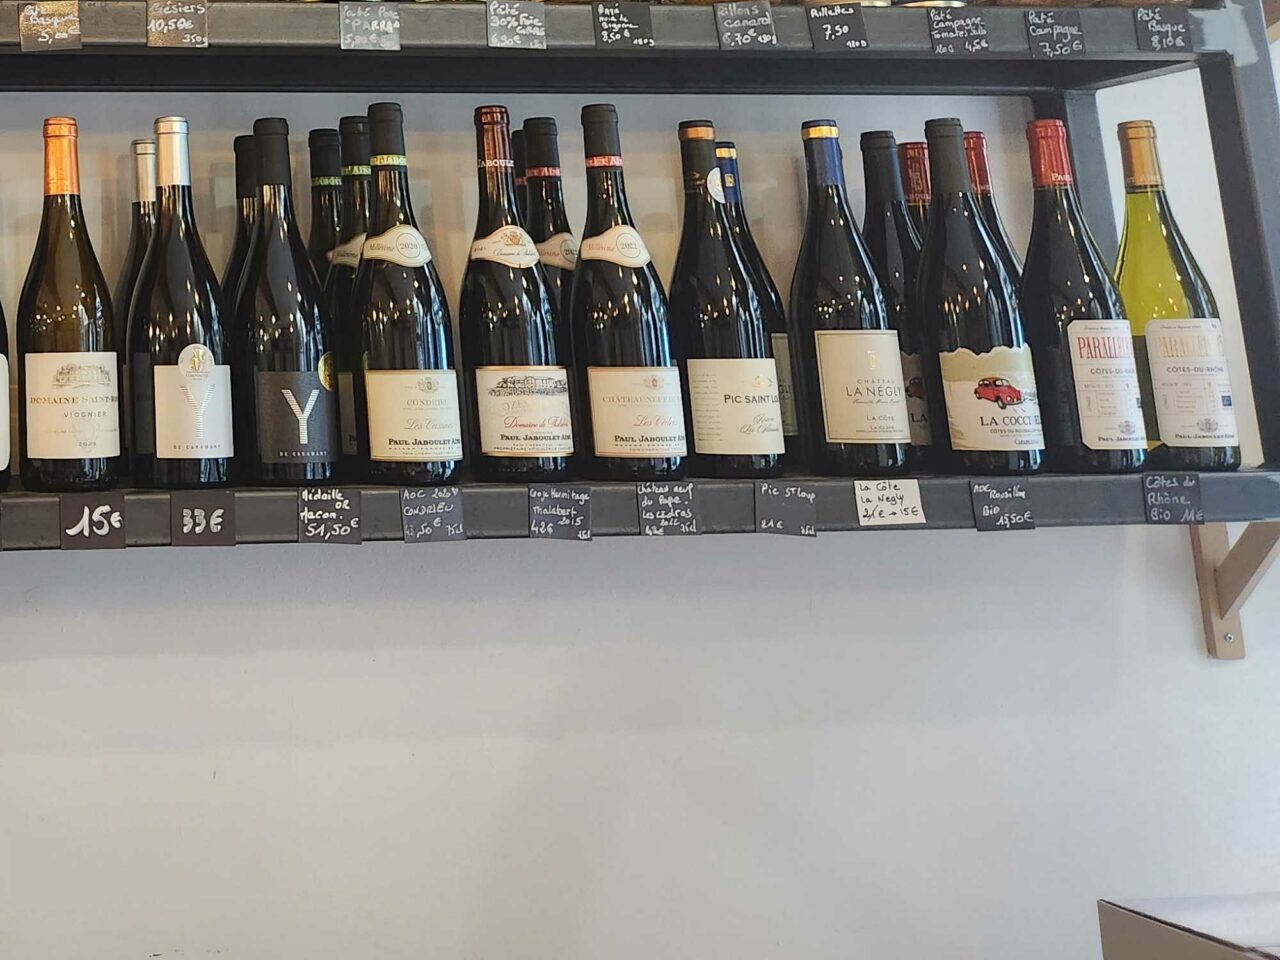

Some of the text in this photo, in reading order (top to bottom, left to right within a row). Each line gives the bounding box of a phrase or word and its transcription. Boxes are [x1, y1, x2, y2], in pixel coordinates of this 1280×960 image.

[490, 14, 543, 28] 30% Foie
[724, 11, 771, 28] canard
[822, 24, 849, 40] 7,50
[1030, 25, 1082, 42] Campagne
[1148, 22, 1185, 38] Basque
[846, 386, 863, 397] LA
[31, 396, 78, 404] DOMAINE
[724, 394, 770, 404] PIC SAINT
[179, 384, 216, 439] Y
[281, 389, 320, 444] Y
[503, 415, 538, 429] Domaine
[911, 413, 928, 422] LA
[980, 417, 998, 426] LA
[859, 481, 900, 492] La Côte
[1183, 476, 1195, 487] du
[302, 489, 345, 501] Médaille
[403, 489, 425, 500] AOC
[761, 484, 779, 495] Pic
[551, 489, 590, 505] Hermitage
[642, 495, 653, 507] du
[861, 494, 904, 505] La Negly
[335, 500, 351, 510] OR
[982, 505, 1000, 516] Bio
[65, 504, 123, 537] 15€
[182, 507, 225, 534] 33€
[558, 517, 583, 526] 2015
